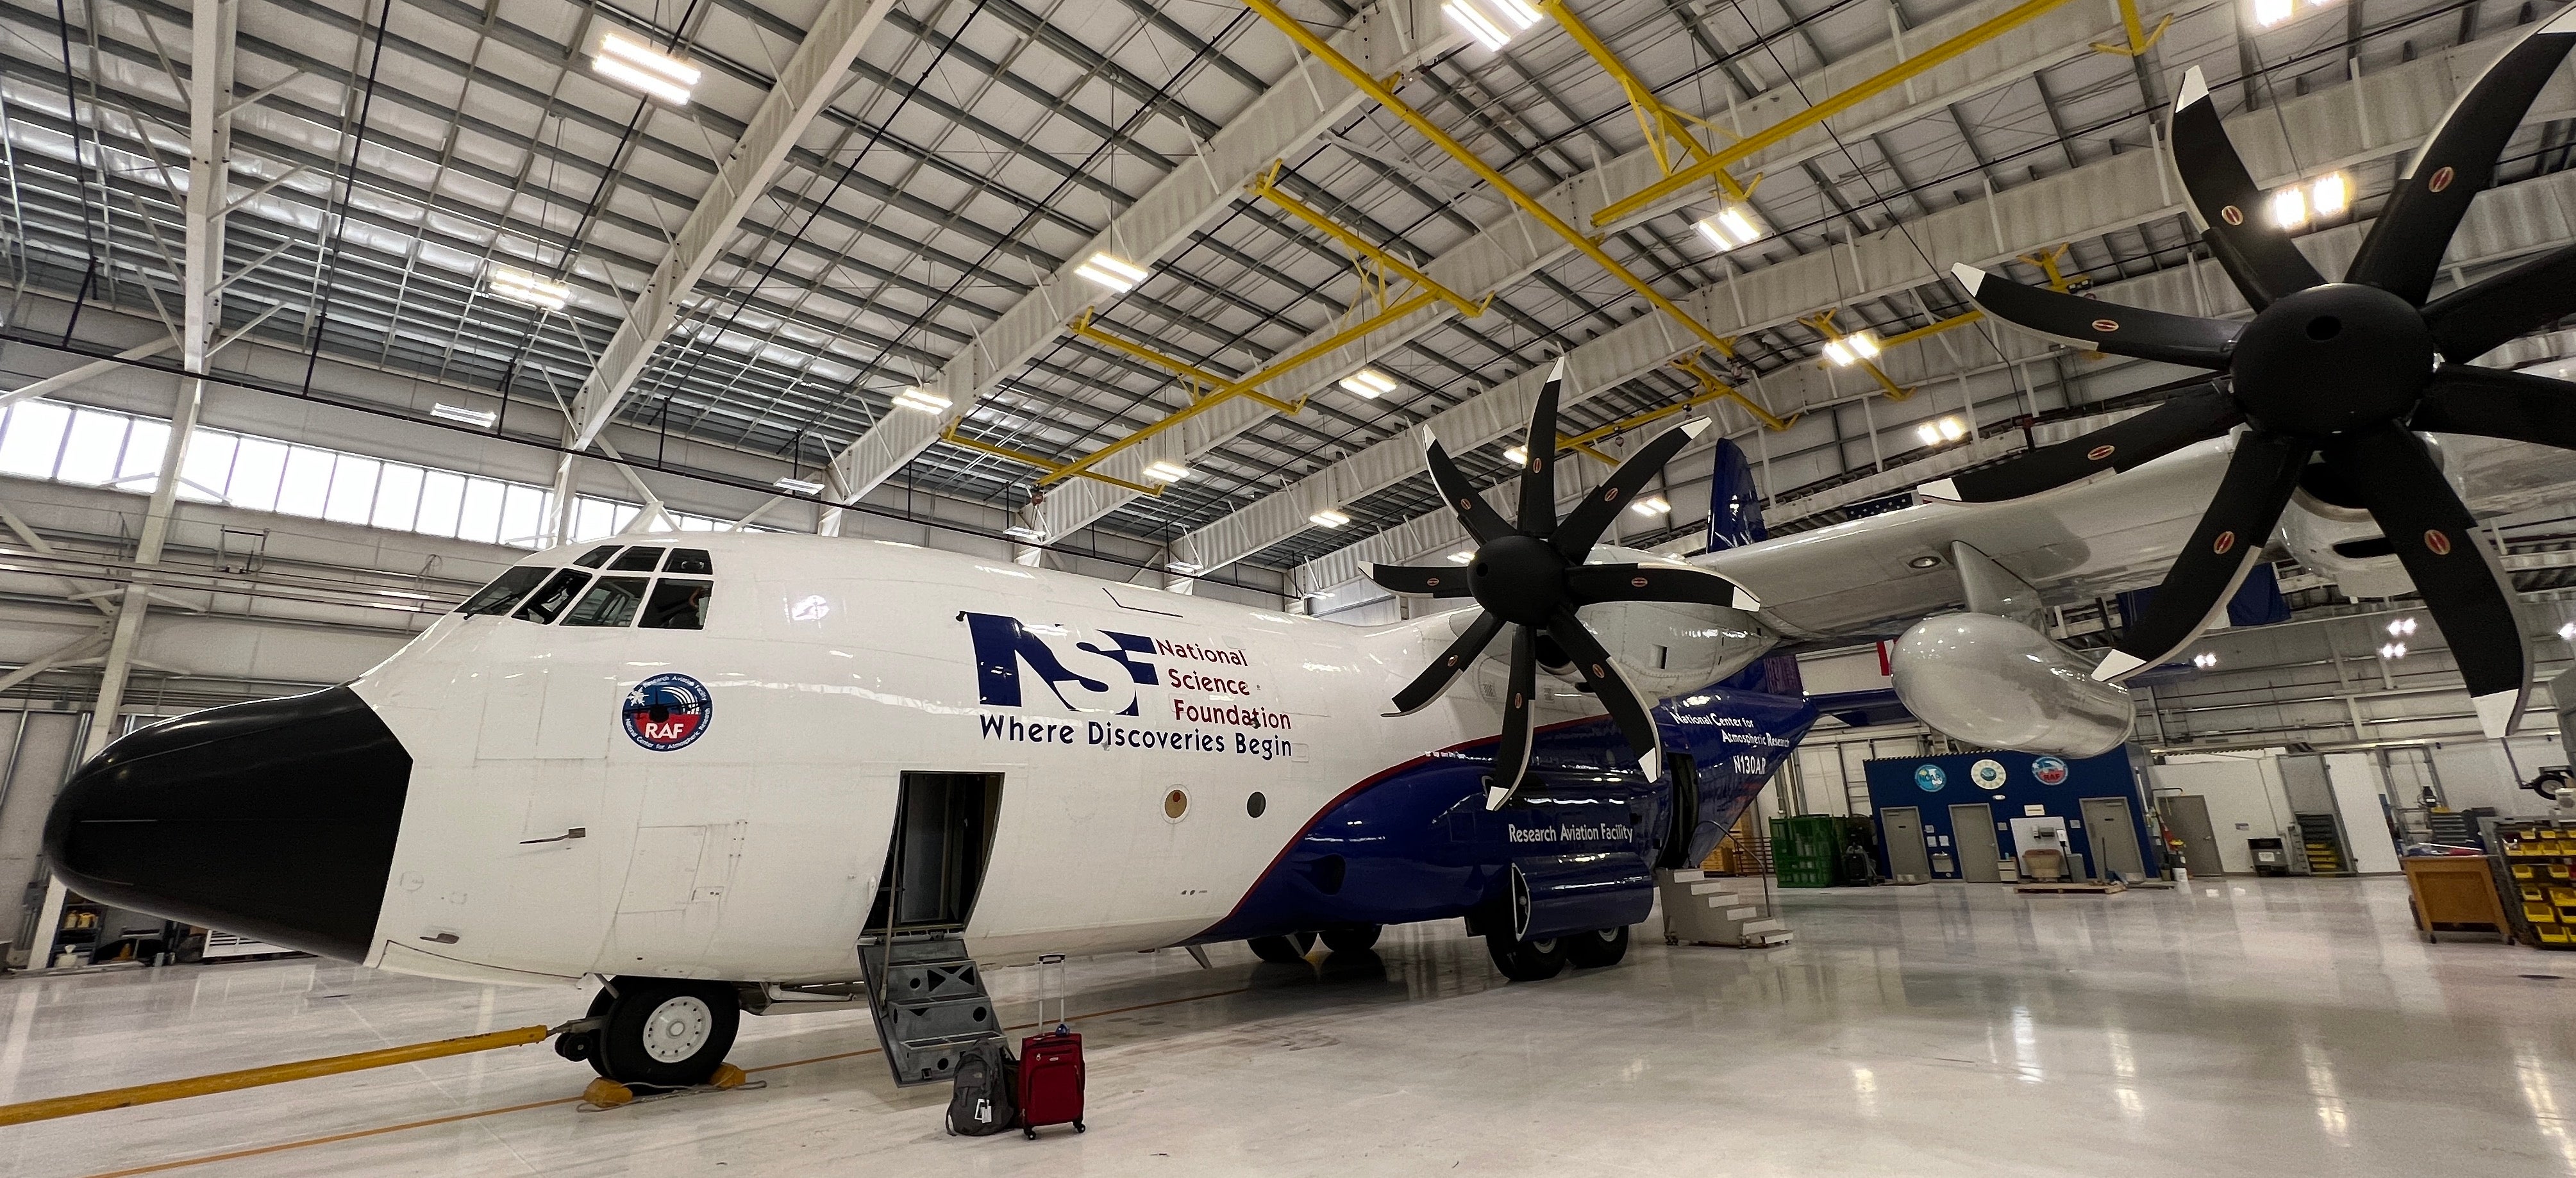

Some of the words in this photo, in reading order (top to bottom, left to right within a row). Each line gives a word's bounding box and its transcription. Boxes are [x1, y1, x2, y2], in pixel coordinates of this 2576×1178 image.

[1155, 638, 1248, 667] National
[966, 611, 1159, 717] NSF
[642, 675, 669, 688] Research
[672, 676, 694, 687] Aviation
[1168, 668, 1250, 695] Science
[1174, 699, 1291, 729] Foundation
[1669, 711, 1712, 726] National
[1710, 713, 1742, 727] Center
[1742, 717, 1755, 728] for
[636, 736, 654, 748] Center
[667, 731, 701, 749] Atmospheric
[645, 722, 684, 739] RAF
[980, 714, 1074, 744] Where
[1088, 721, 1225, 752] Discoveries
[1235, 732, 1292, 761] Begin
[1721, 729, 1767, 746] Atmospheric
[1766, 732, 1790, 747] Research
[1733, 754, 1766, 775] N130AR
[1509, 824, 1557, 842] Research
[1560, 823, 1599, 842] Aviation
[1600, 823, 1633, 843] Facility
